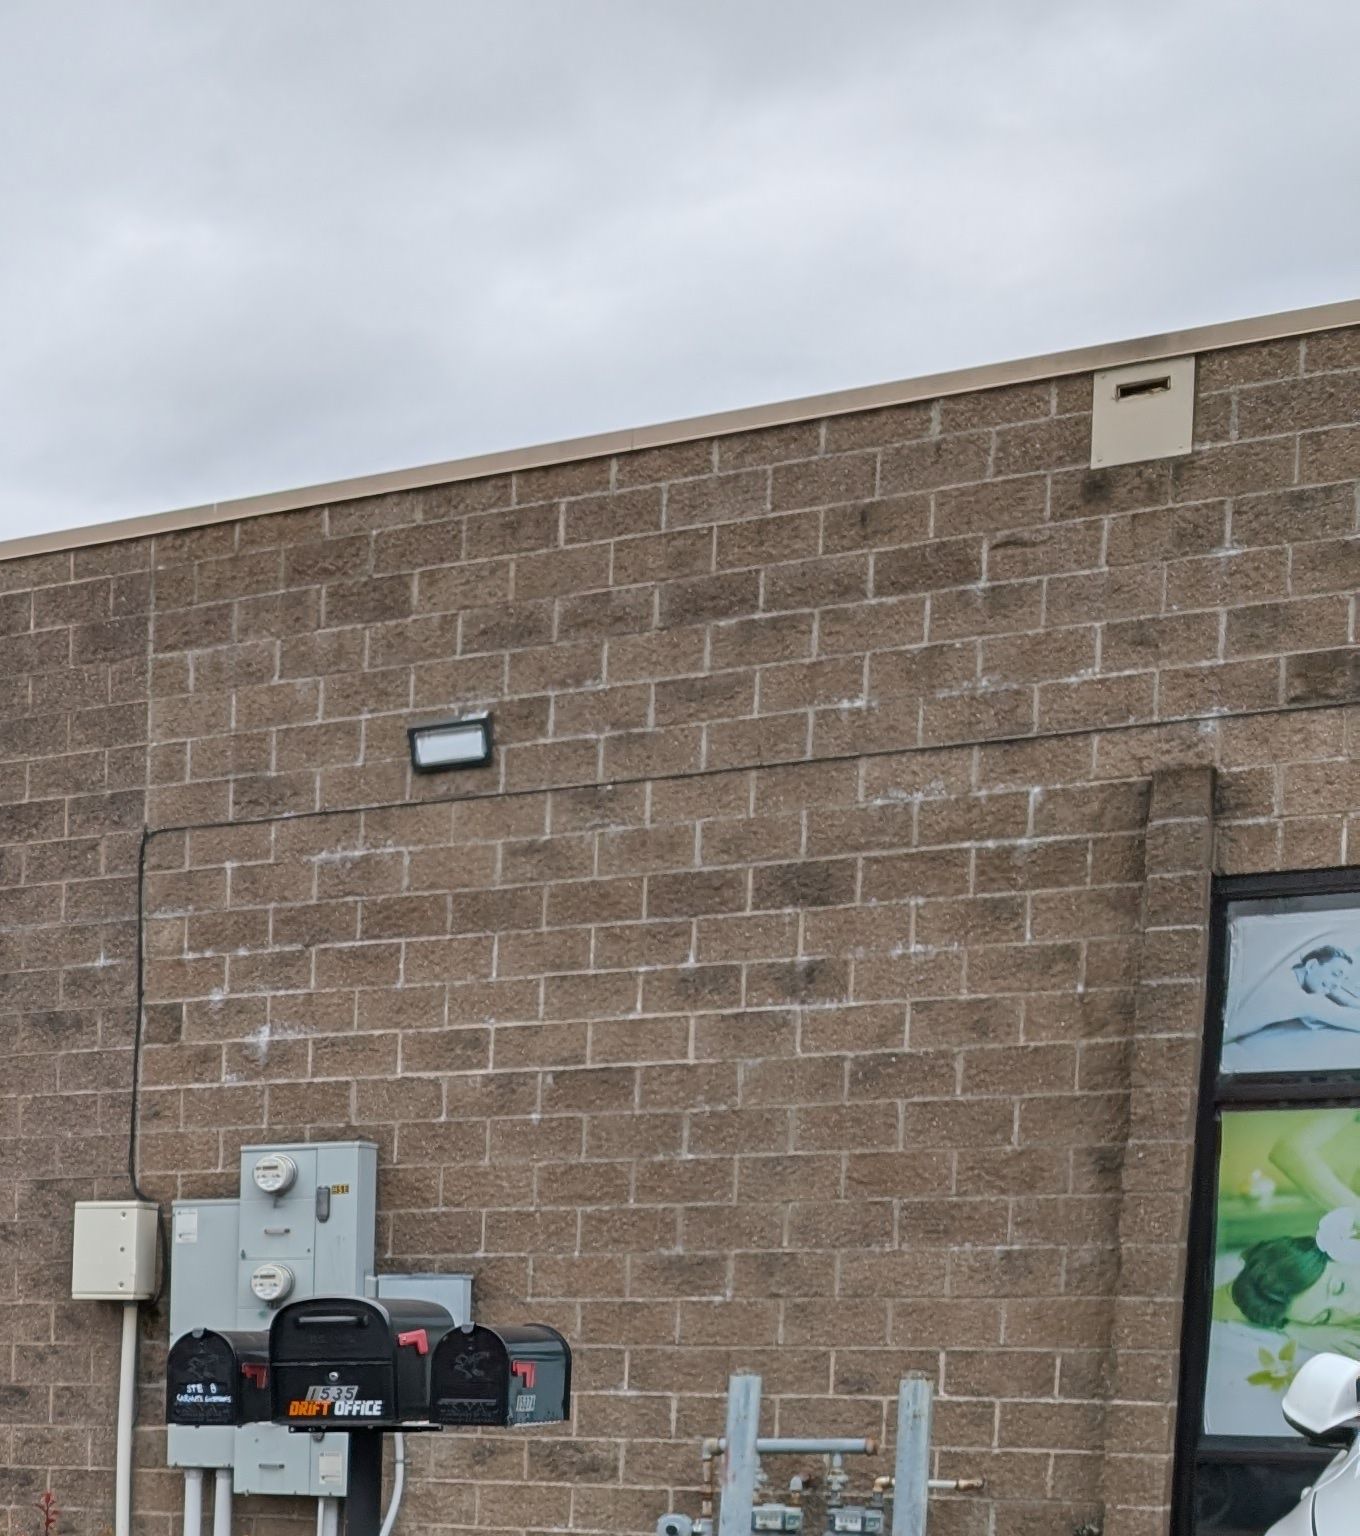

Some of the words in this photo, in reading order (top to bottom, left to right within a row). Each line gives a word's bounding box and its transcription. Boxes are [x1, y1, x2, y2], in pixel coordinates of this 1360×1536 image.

[186, 1383, 204, 1394] STE
[309, 1386, 356, 1401] 1535
[288, 1400, 332, 1416] DRIFT
[333, 1400, 383, 1416] OFFICE
